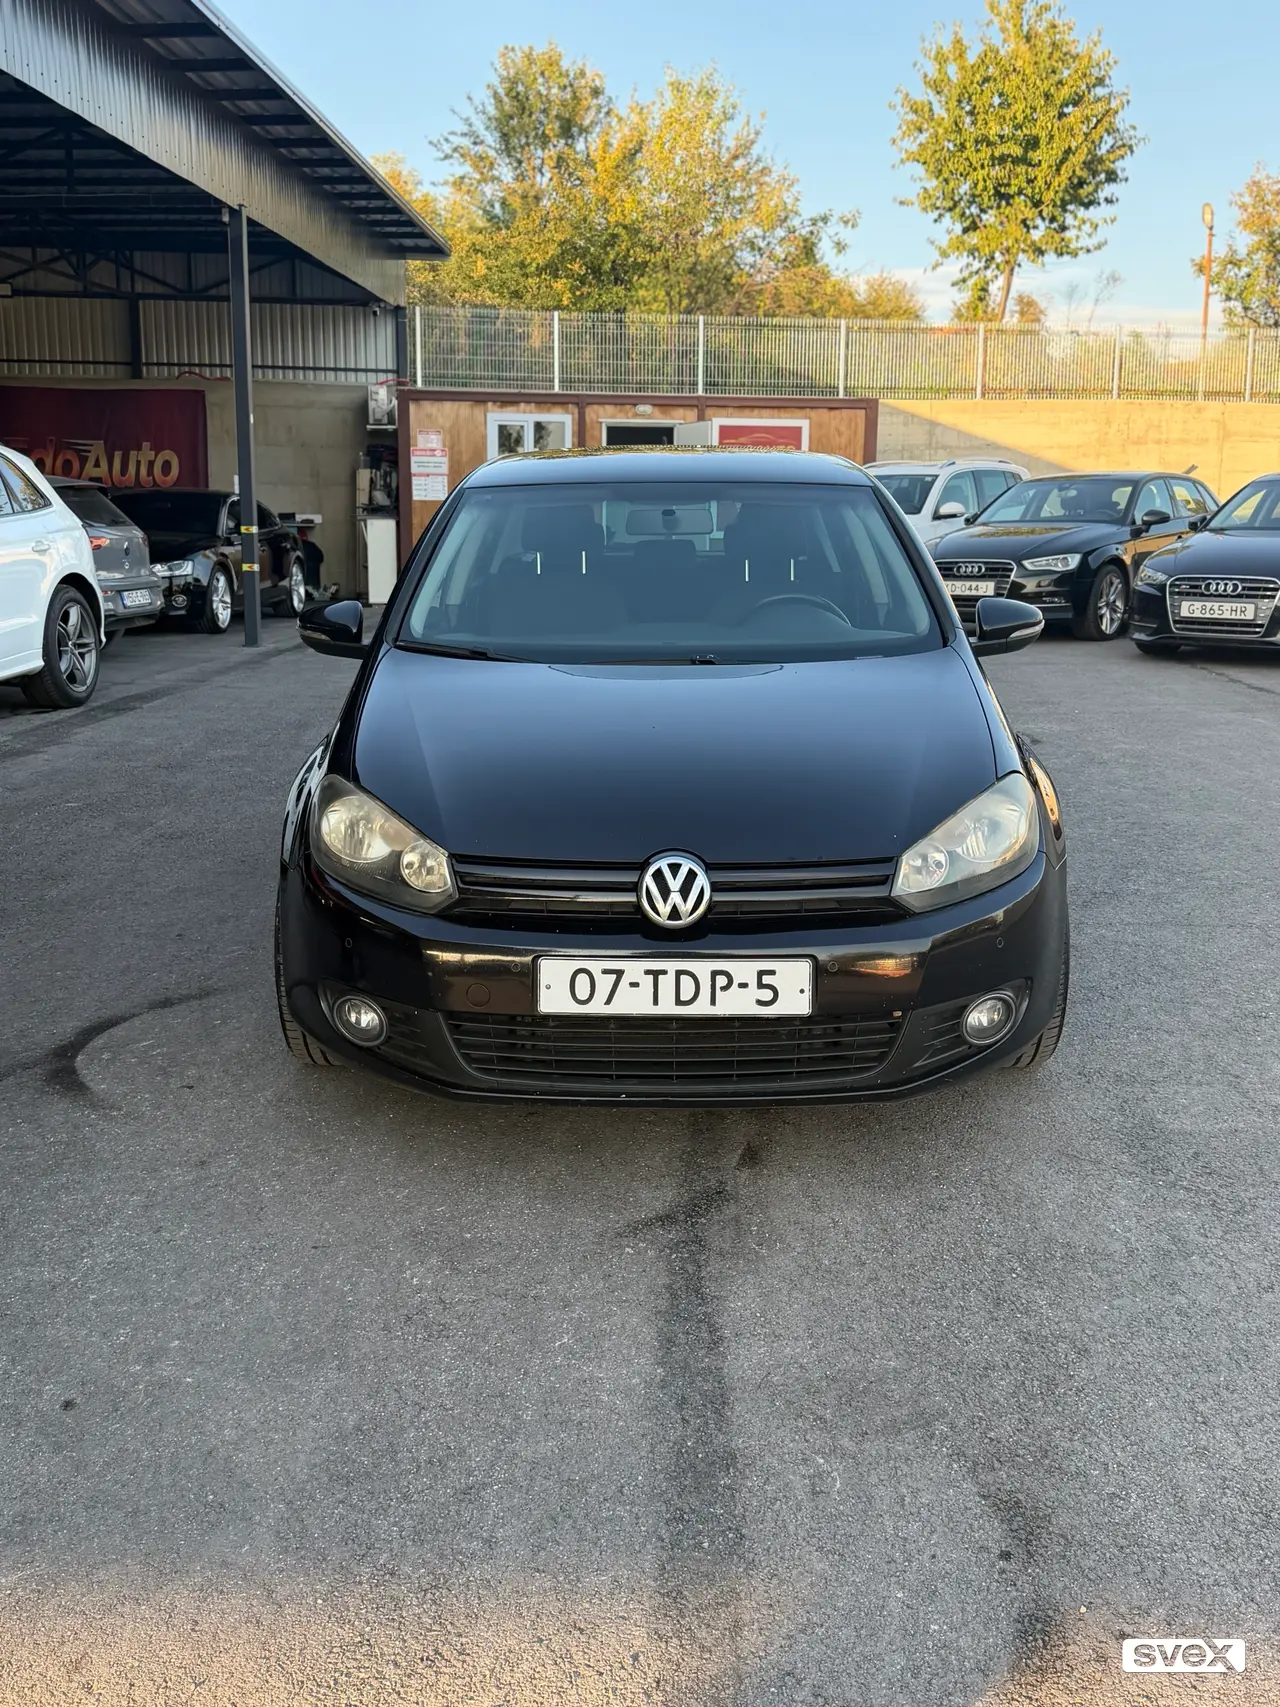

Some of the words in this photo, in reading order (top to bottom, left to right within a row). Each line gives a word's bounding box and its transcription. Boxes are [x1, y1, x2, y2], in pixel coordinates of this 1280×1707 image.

[1187, 603, 1248, 617] G-865-HR
[642, 858, 709, 925] VW
[568, 967, 780, 1008] 07-TDP-5
